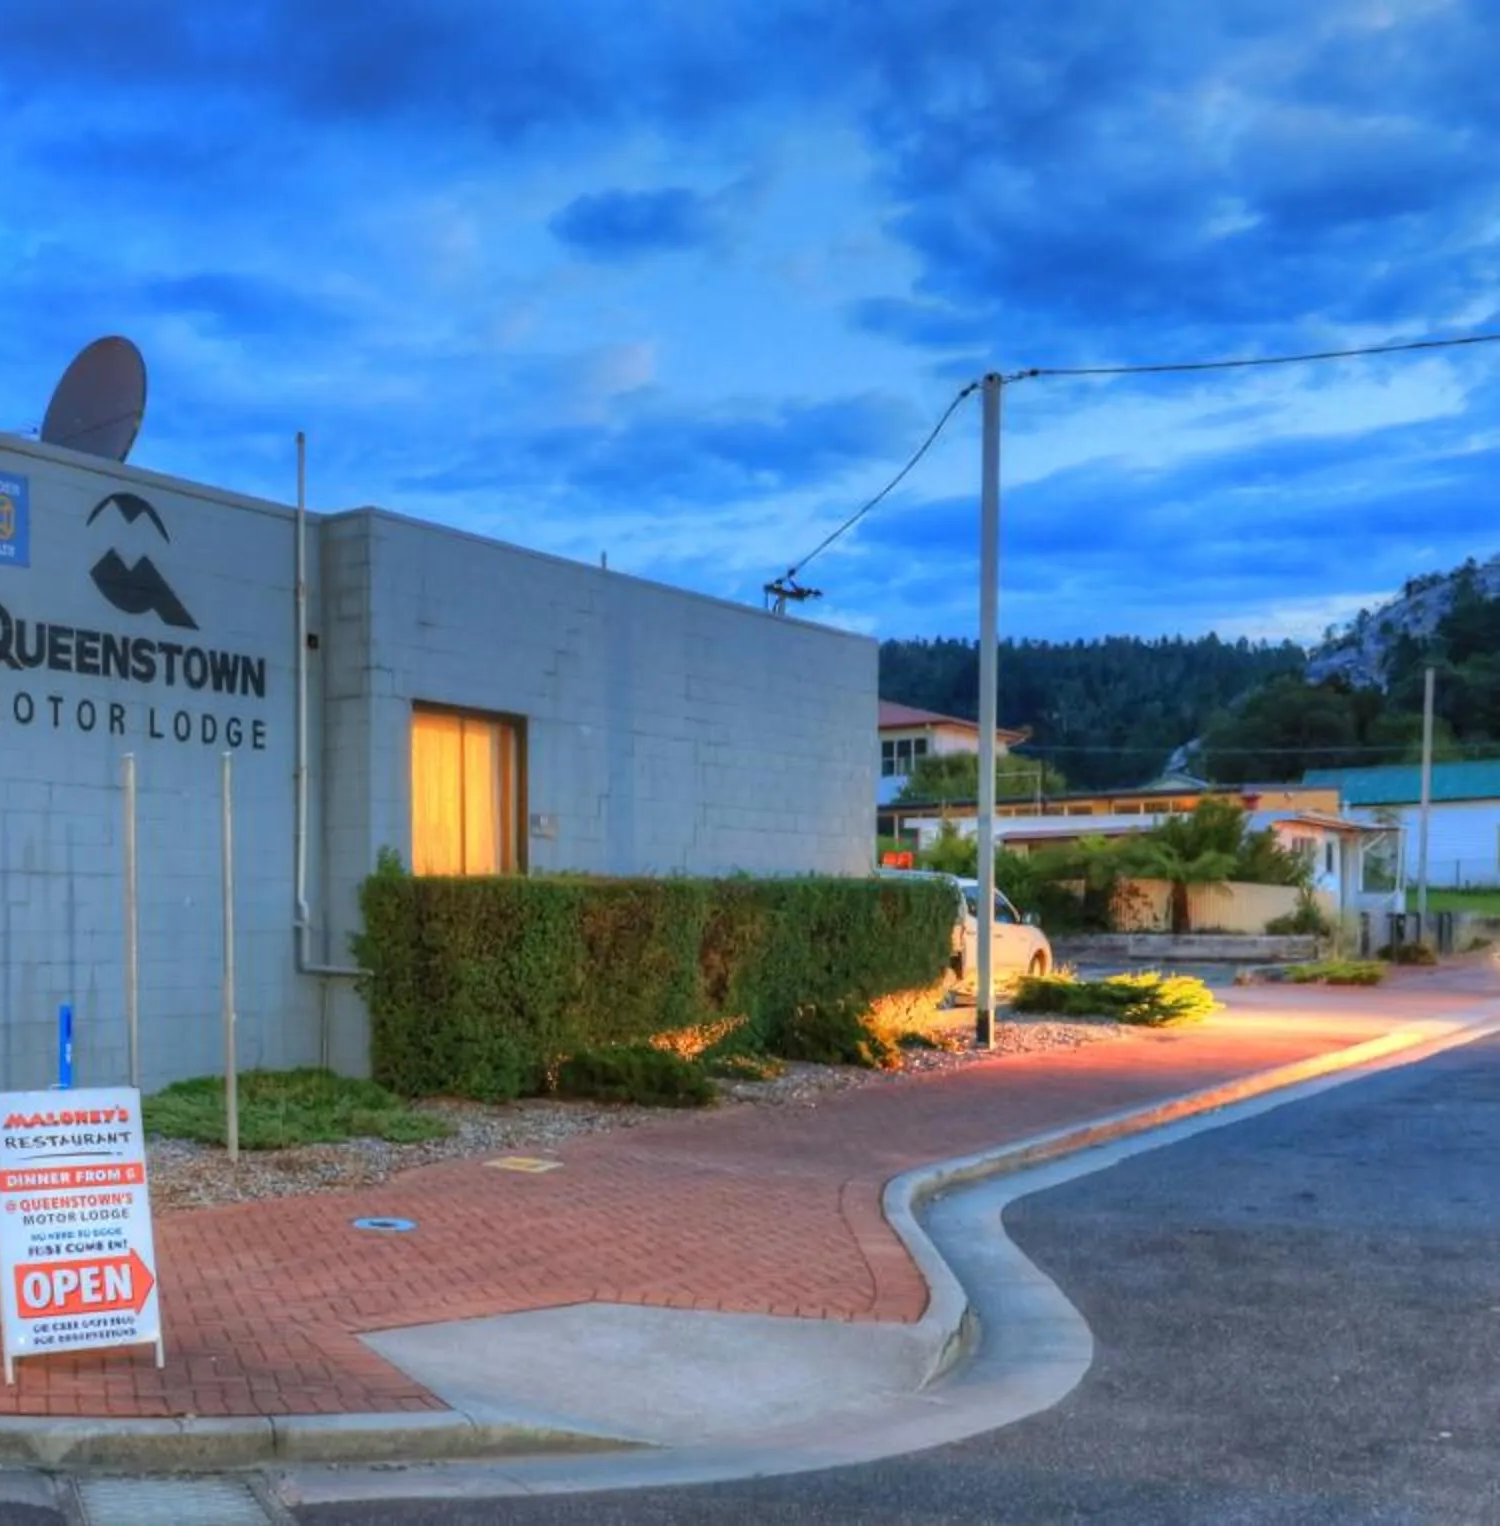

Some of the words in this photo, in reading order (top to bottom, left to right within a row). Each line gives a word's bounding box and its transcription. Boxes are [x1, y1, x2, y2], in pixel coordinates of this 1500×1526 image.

[149, 707, 267, 750] LODGE
[4, 1131, 132, 1150] RESTAURANT
[6, 1172, 71, 1189] DINNER
[76, 1169, 121, 1185] FROM
[19, 1192, 134, 1212] QUEENSTOWN'S
[23, 1210, 77, 1226] MOTOR
[80, 1208, 130, 1224] LODGE
[23, 1263, 133, 1310] OPEN
